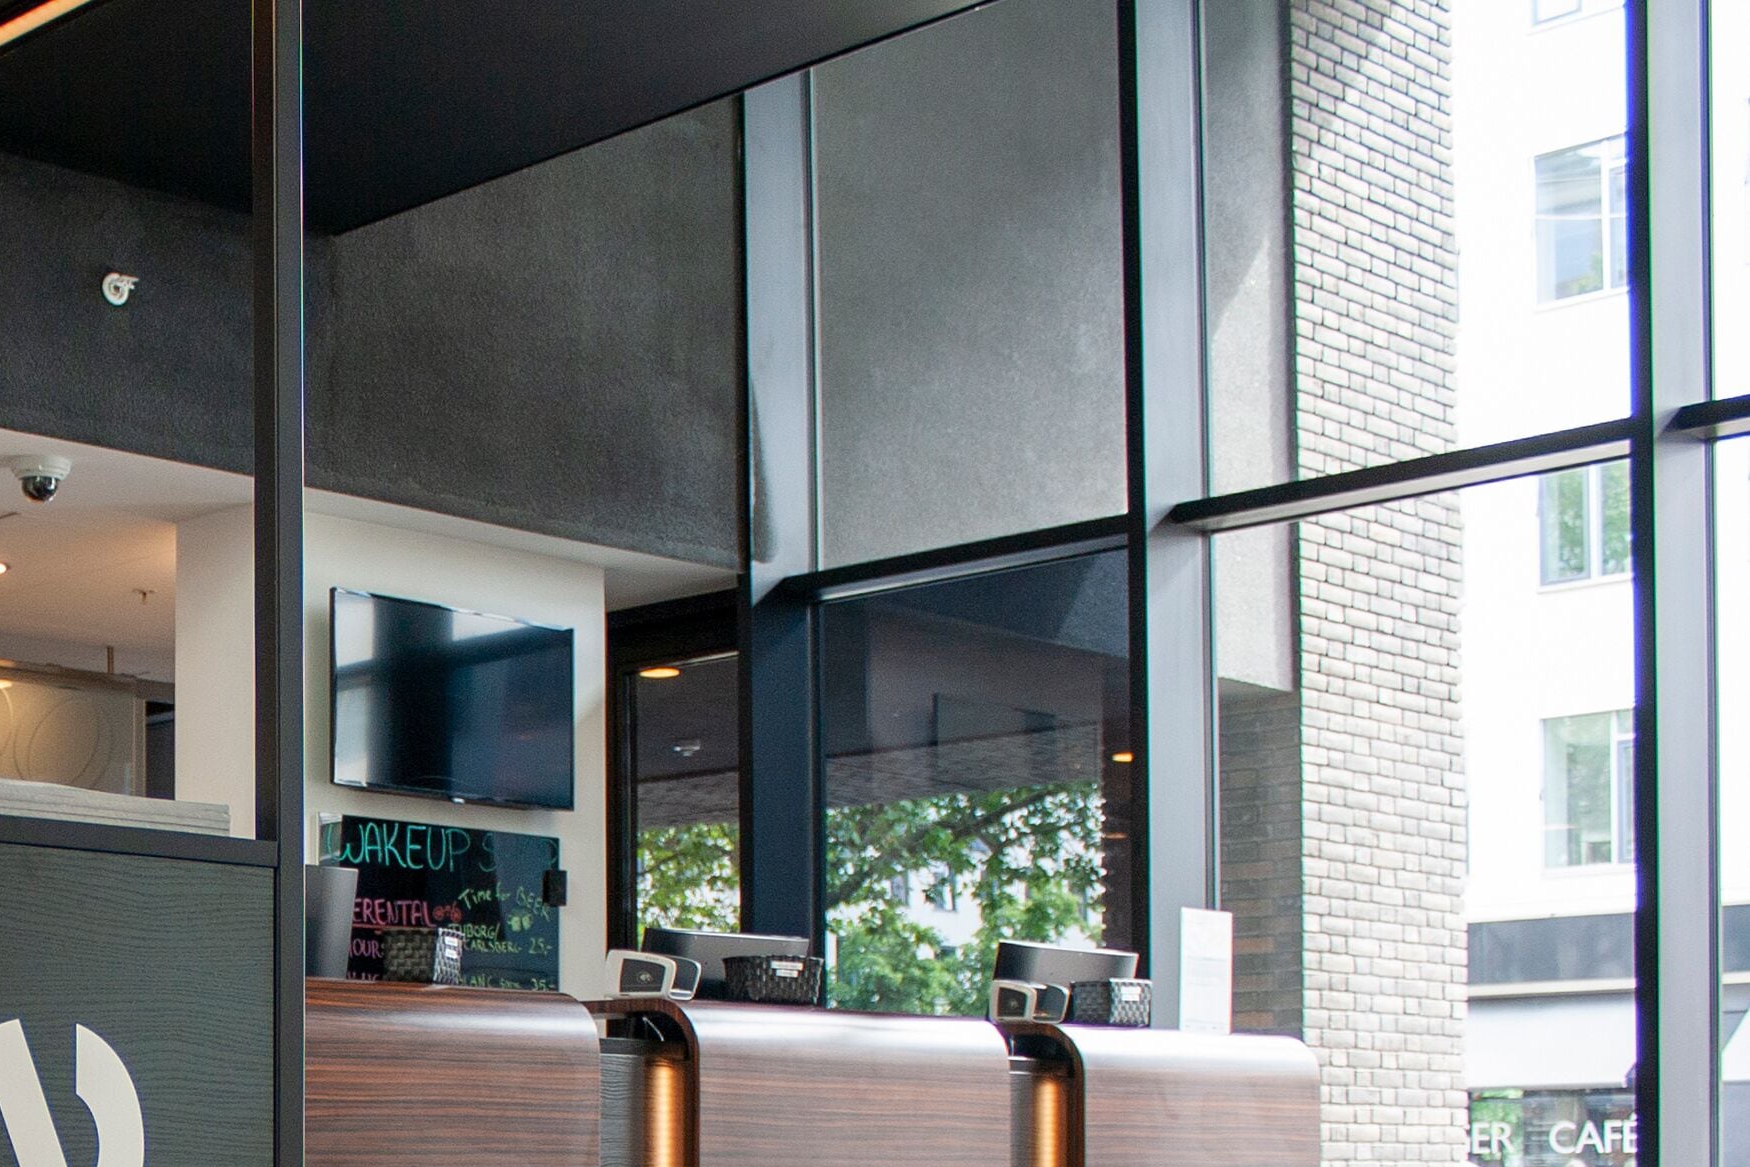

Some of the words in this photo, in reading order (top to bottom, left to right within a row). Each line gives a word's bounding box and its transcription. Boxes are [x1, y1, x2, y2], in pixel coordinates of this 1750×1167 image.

[327, 821, 471, 873] WAKEUP
[458, 887, 492, 910] Time
[1549, 1111, 1638, 1154] CAFÉ
